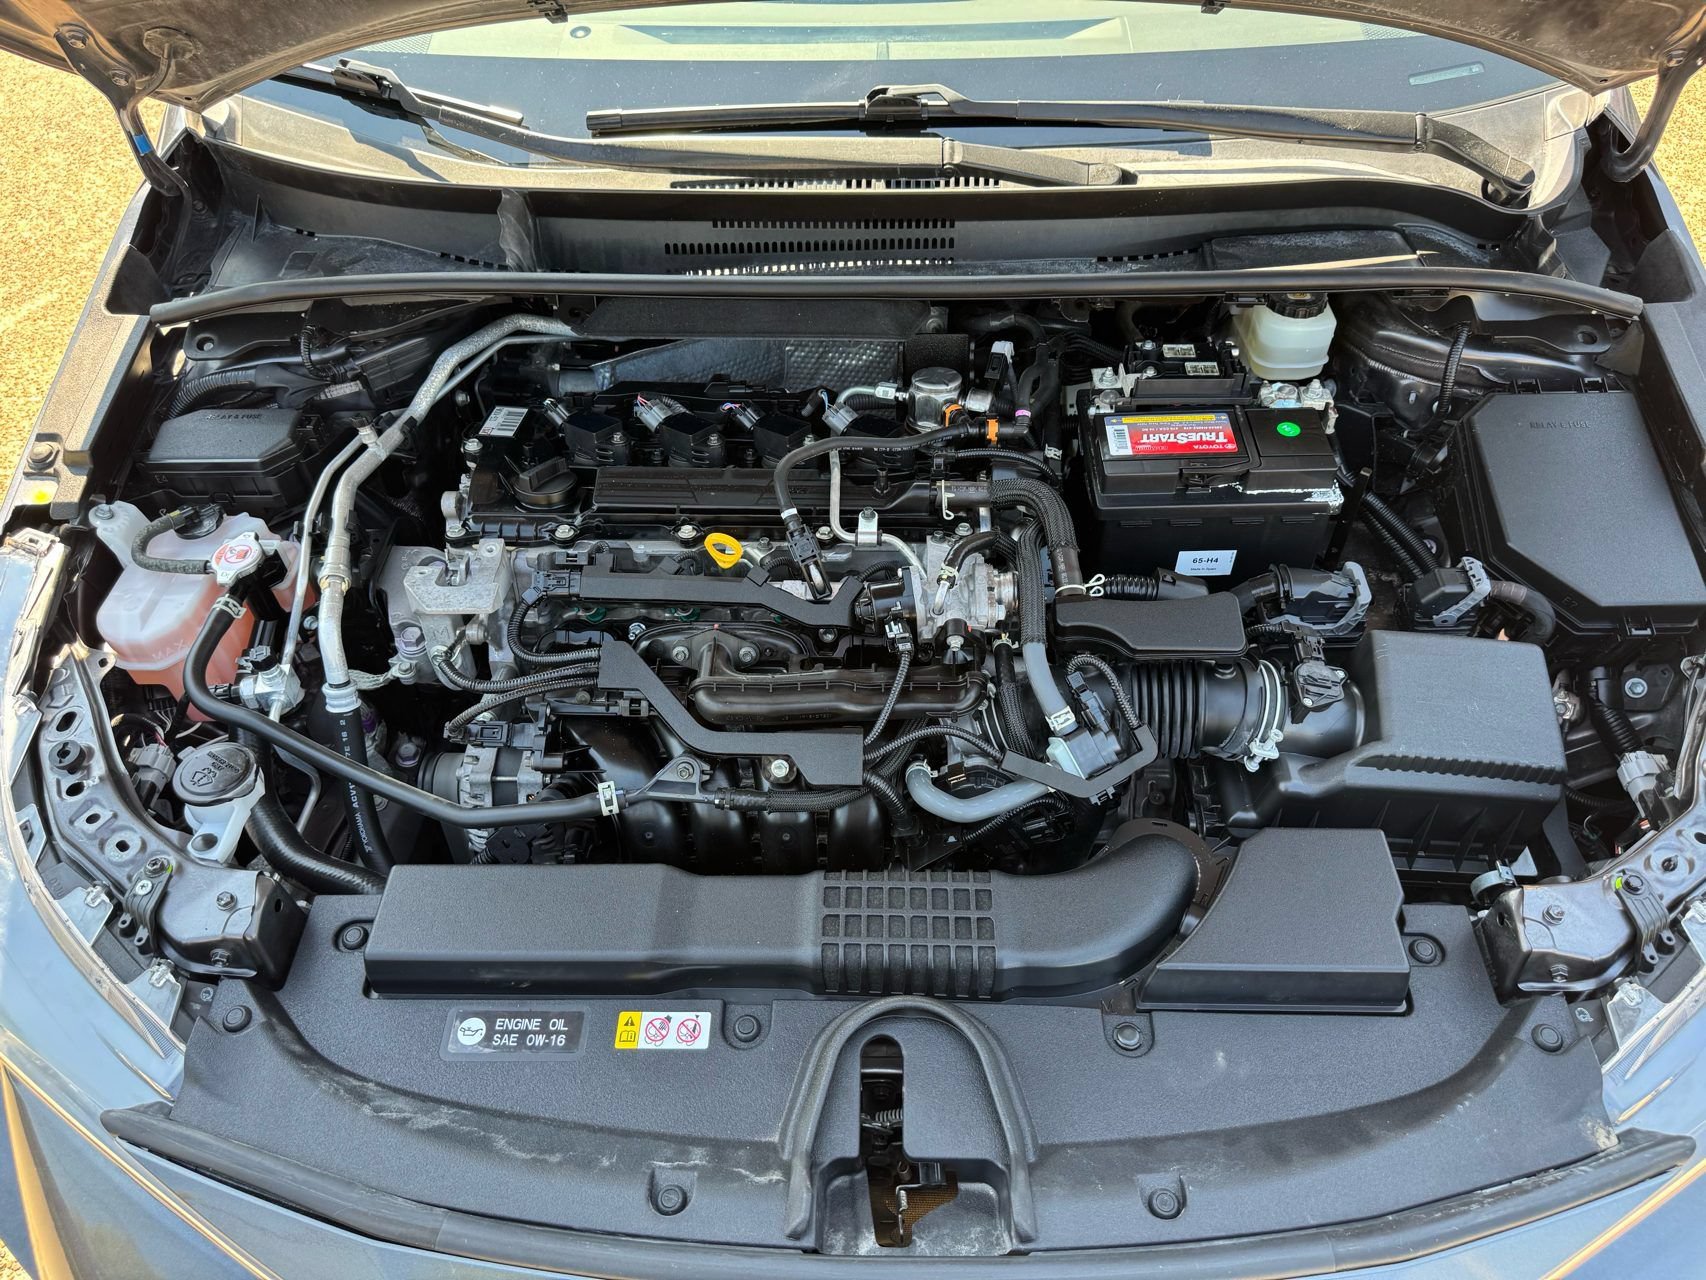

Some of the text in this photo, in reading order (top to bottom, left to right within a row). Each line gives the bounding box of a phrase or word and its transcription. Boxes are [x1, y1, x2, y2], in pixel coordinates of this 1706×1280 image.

[495, 1018, 569, 1031] ENGINE OIL
[492, 1033, 519, 1046] SAE
